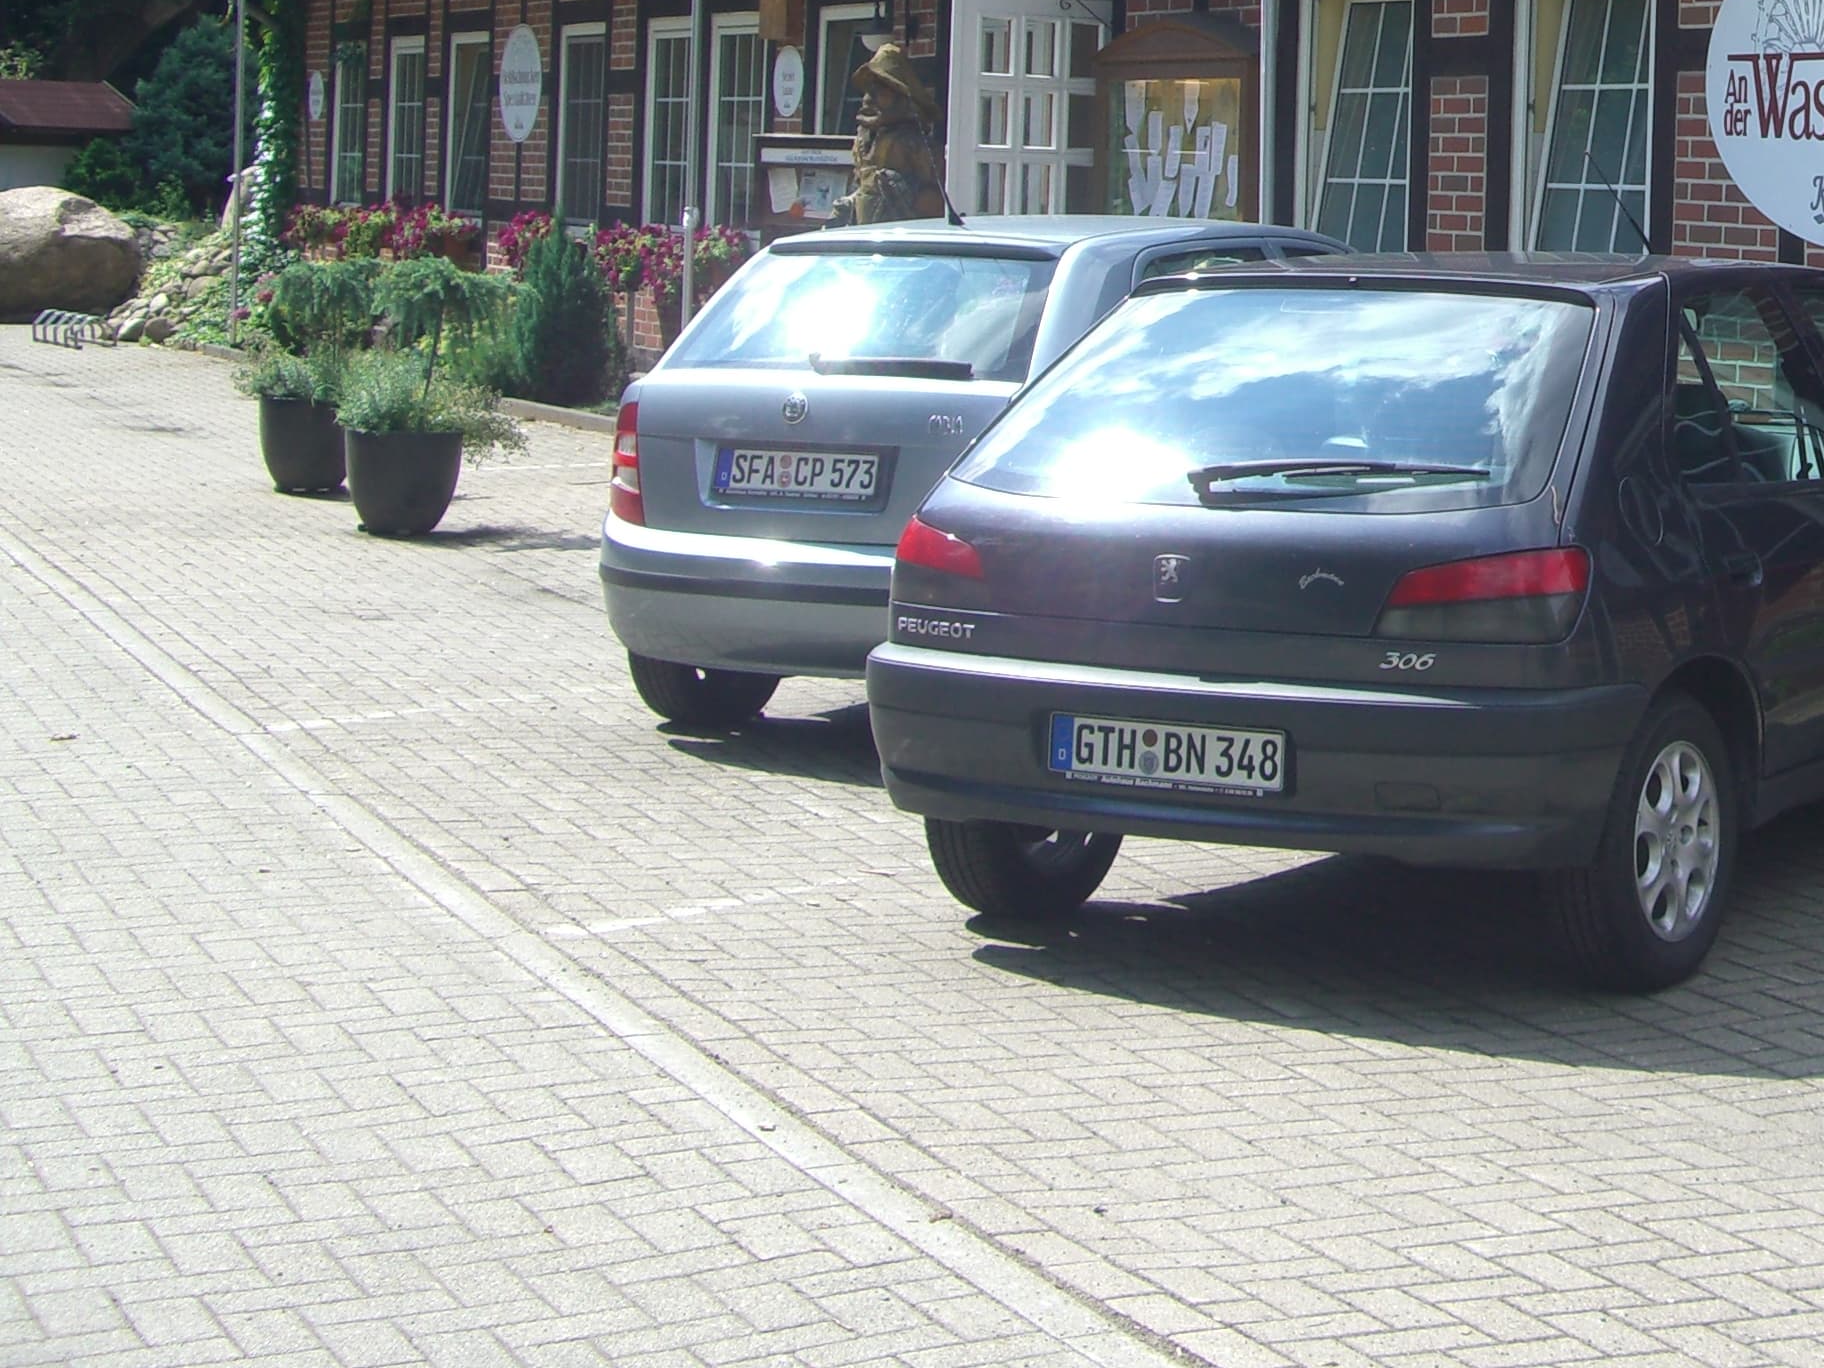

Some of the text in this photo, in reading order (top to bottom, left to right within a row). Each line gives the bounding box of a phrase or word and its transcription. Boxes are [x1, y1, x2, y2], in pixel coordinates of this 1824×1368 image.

[1724, 69, 1748, 104] An
[1723, 105, 1751, 137] der
[732, 453, 874, 490] SFA CP 573
[897, 616, 976, 640] PEUGEOT
[1378, 651, 1437, 672] 306
[1058, 747, 1066, 760] D
[1075, 723, 1279, 782] GTH BN 348
